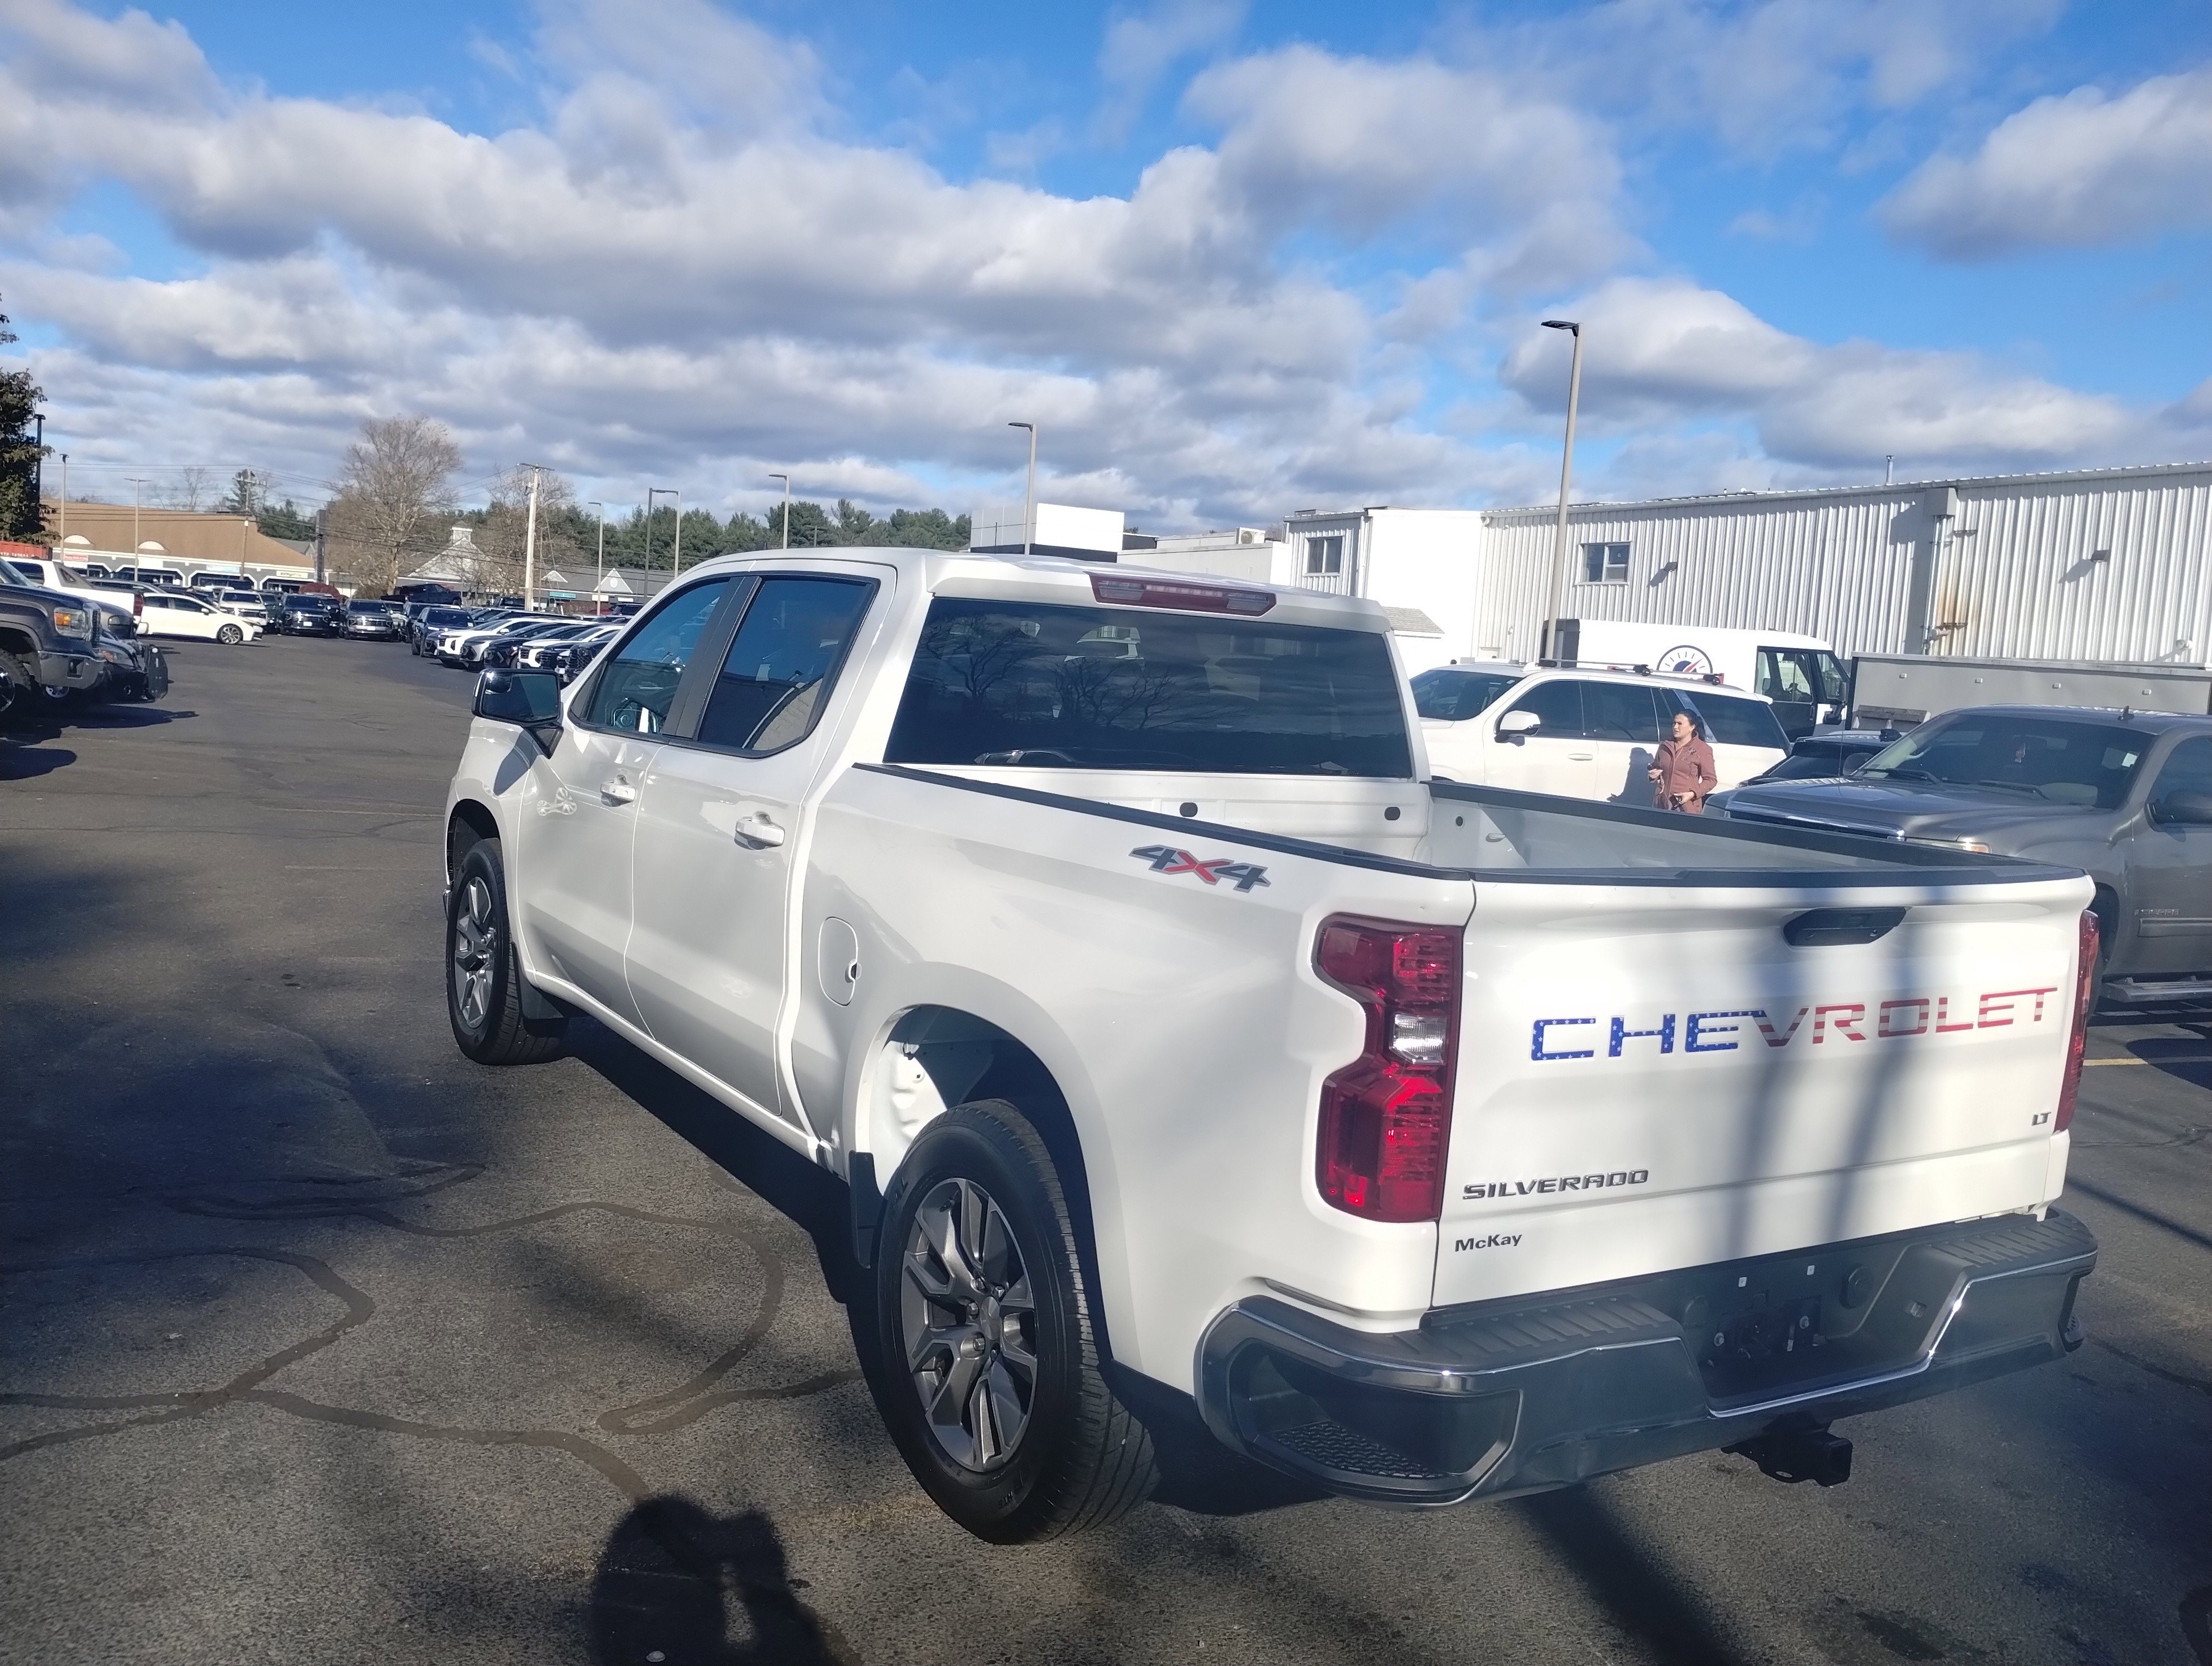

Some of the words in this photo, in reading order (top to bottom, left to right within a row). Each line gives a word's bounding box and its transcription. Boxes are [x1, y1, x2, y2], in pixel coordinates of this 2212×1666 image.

[1531, 986, 2058, 1061] CHEVROLET
[2031, 1111, 2052, 1126] LT
[1462, 1168, 1649, 1200] SILVERADO
[1455, 1234, 1522, 1252] McKay
